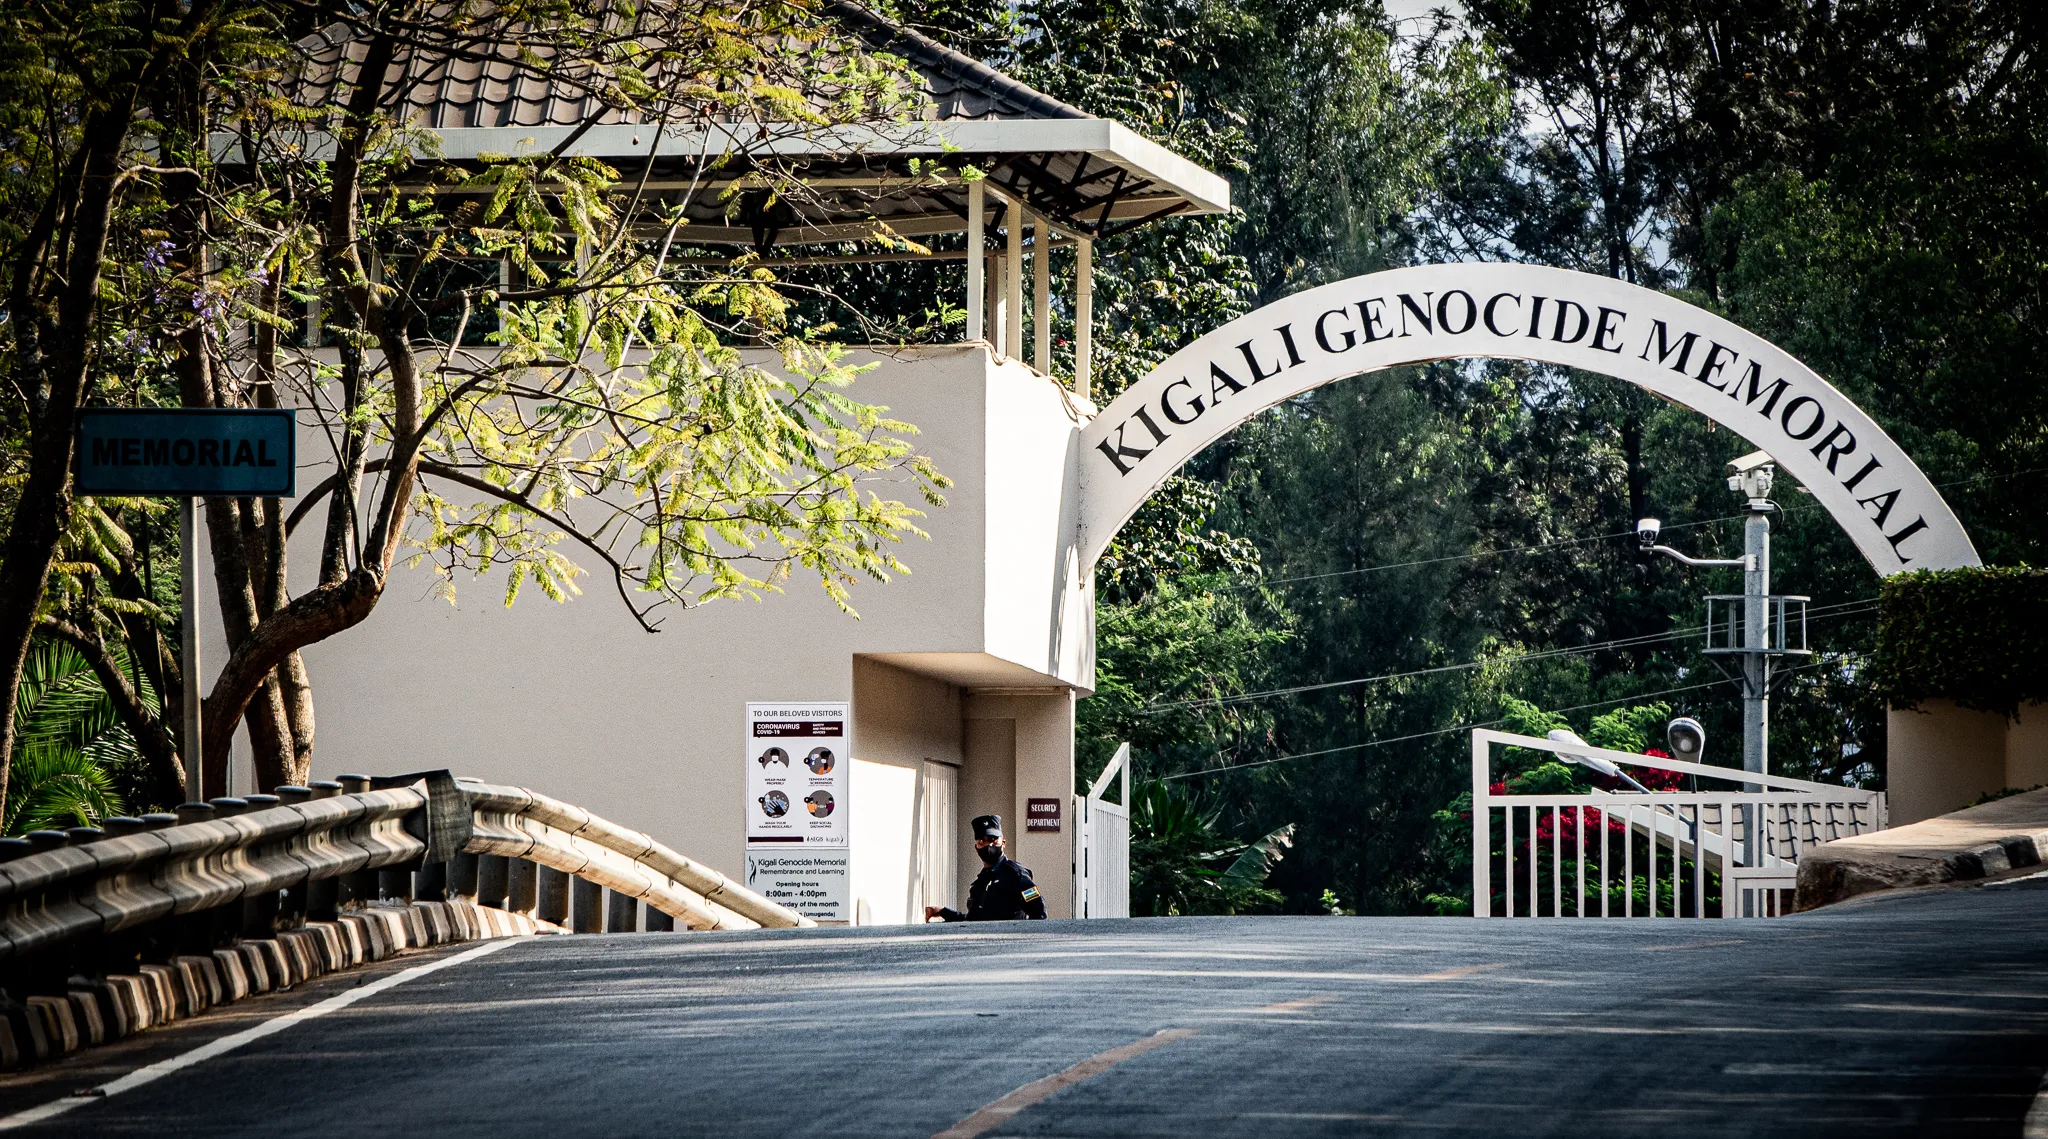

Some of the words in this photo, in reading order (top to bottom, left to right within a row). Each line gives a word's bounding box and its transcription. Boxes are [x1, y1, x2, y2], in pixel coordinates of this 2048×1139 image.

[1095, 322, 1306, 478] KIGALI
[1314, 289, 1627, 354] GENOCIDE
[1637, 318, 1930, 565] MEMORIAL
[91, 438, 277, 467] MEMORIAL
[811, 709, 843, 717] VISITORS
[1027, 818, 1060, 827] DEPARTMENT
[758, 858, 777, 868] Kigali
[778, 858, 813, 866] Genocide
[813, 858, 847, 866] Memorial
[818, 868, 845, 876] Learning
[799, 890, 827, 898] 4:00pm
[776, 901, 799, 909] turday
